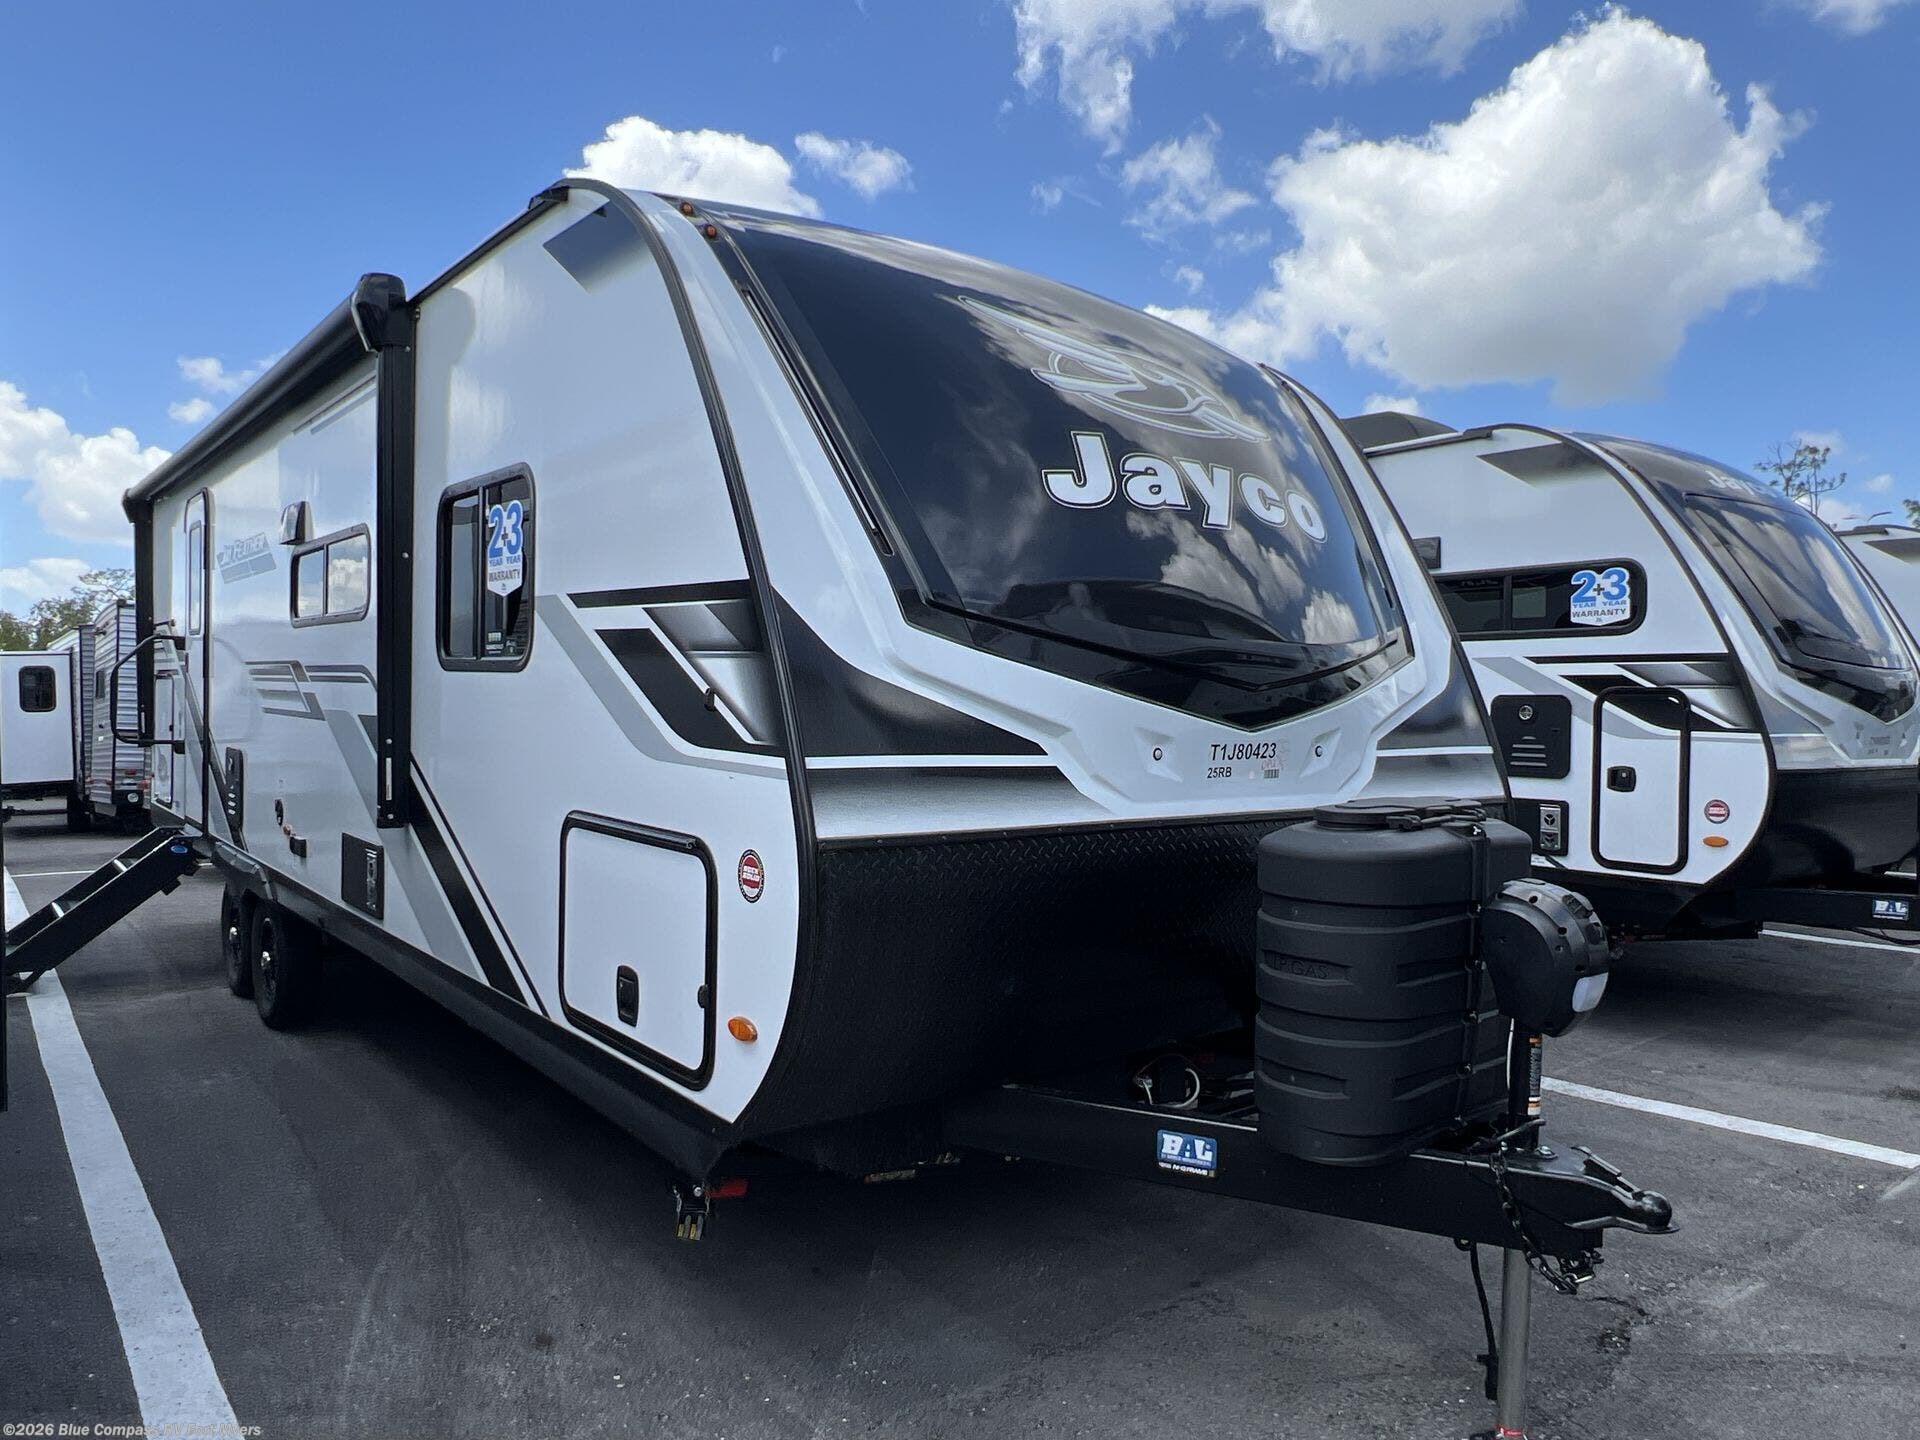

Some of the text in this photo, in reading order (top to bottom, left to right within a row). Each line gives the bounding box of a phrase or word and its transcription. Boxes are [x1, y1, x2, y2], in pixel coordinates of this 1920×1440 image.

[1041, 431, 1328, 543] Jayco
[489, 568, 520, 582] WARRANTY
[1572, 608, 1626, 618] WARRANTY
[1210, 742, 1277, 761] T1J80423
[1207, 766, 1232, 779] 25RB
[1161, 1133, 1213, 1162] BAL
